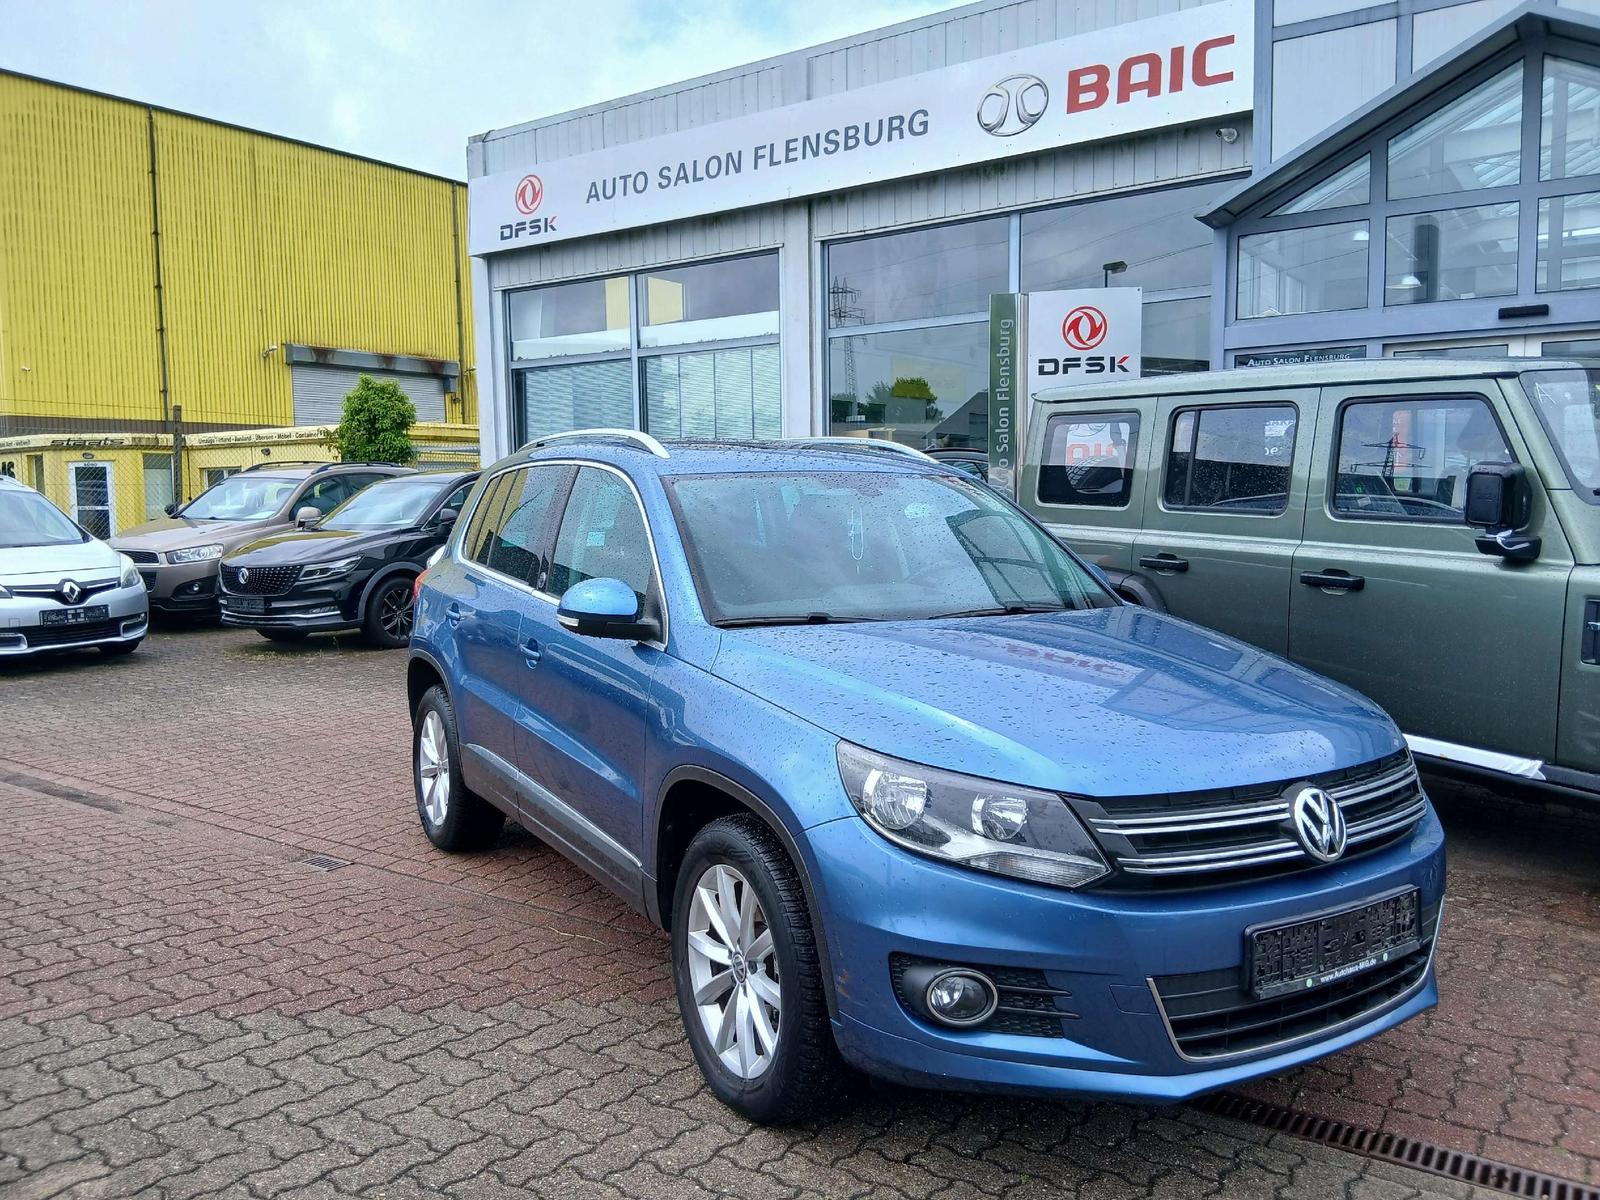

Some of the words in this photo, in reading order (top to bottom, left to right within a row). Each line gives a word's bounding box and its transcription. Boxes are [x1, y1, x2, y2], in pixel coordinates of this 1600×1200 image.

[1066, 34, 1235, 114] BAIC
[586, 170, 649, 204] AUTO
[658, 150, 742, 190] SALON
[753, 108, 929, 170] FLENSBURG
[500, 215, 558, 241] DFSK
[996, 318, 1014, 400] Flensburg
[1038, 355, 1130, 376] DFSK
[1247, 358, 1271, 367] AUTO
[1273, 357, 1300, 365] SALON
[996, 408, 1010, 453] Salon
